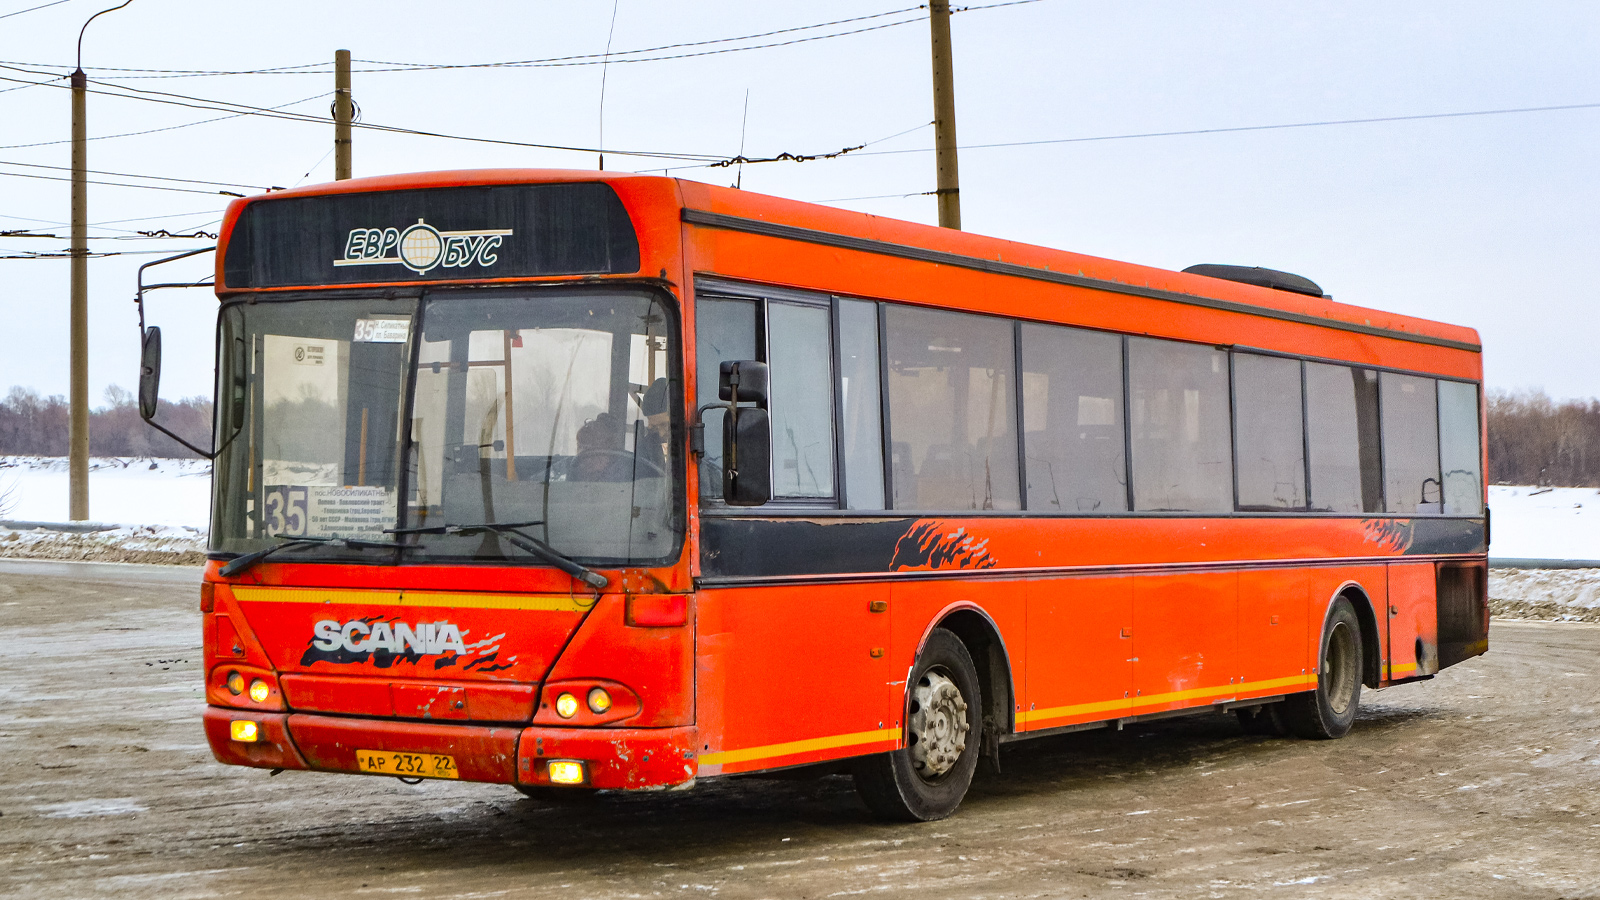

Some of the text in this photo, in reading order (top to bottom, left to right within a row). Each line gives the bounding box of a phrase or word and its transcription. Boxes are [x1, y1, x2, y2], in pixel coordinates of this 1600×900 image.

[354, 320, 375, 340] 35
[266, 491, 306, 538] 35
[313, 619, 467, 655] SCANIA
[393, 754, 425, 773] 232
[434, 756, 451, 770] 22
